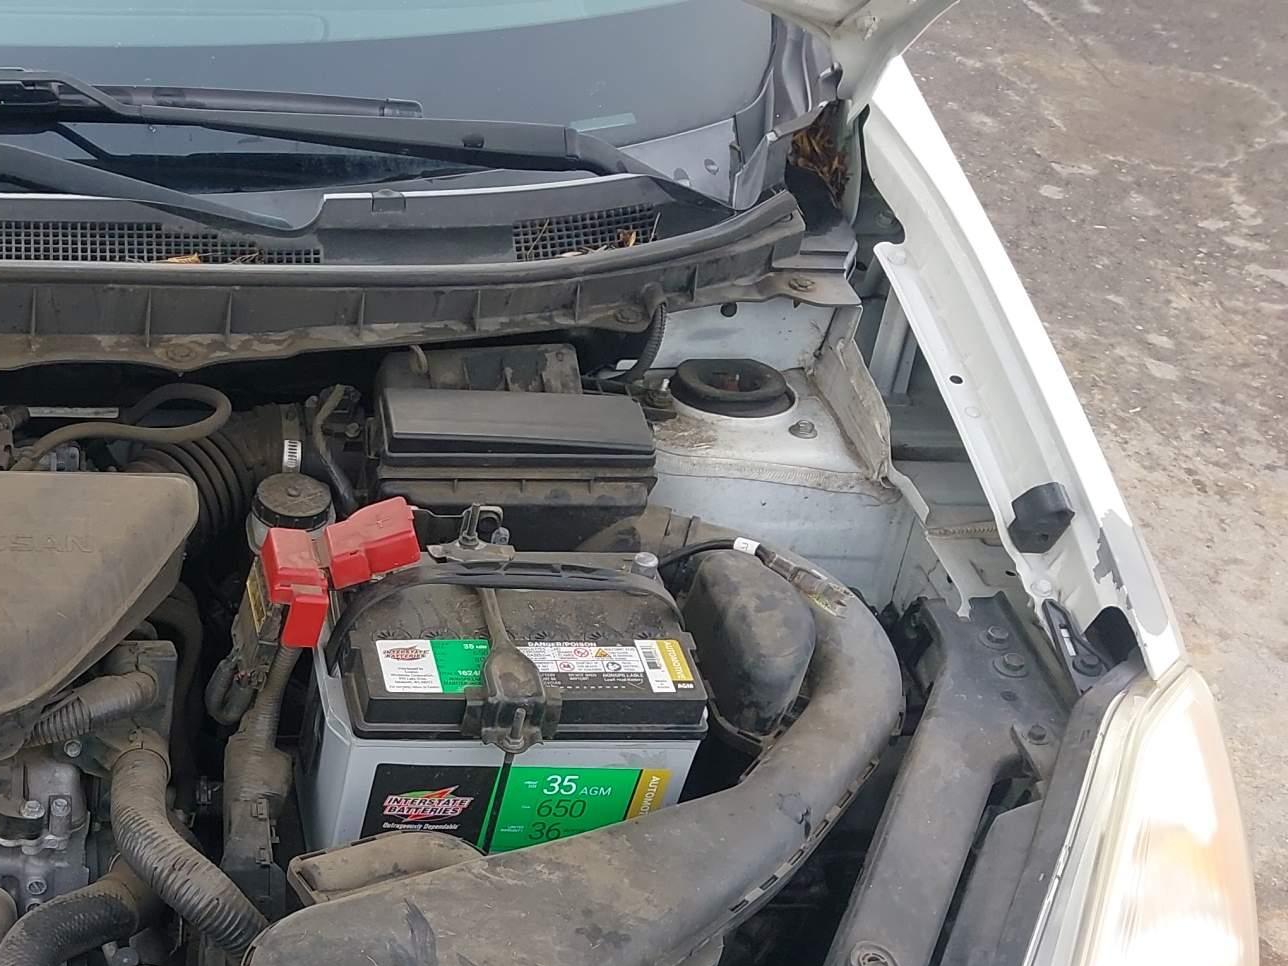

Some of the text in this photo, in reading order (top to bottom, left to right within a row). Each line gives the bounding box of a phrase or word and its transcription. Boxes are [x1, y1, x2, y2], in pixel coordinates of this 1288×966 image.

[543, 774, 579, 795] 35
[580, 786, 612, 796] AGM
[385, 796, 470, 806] INTERSTATE
[639, 775, 661, 816] AUTOMOT
[385, 806, 462, 815] BATTERIES
[536, 799, 587, 818] 650
[528, 822, 561, 840] 36
